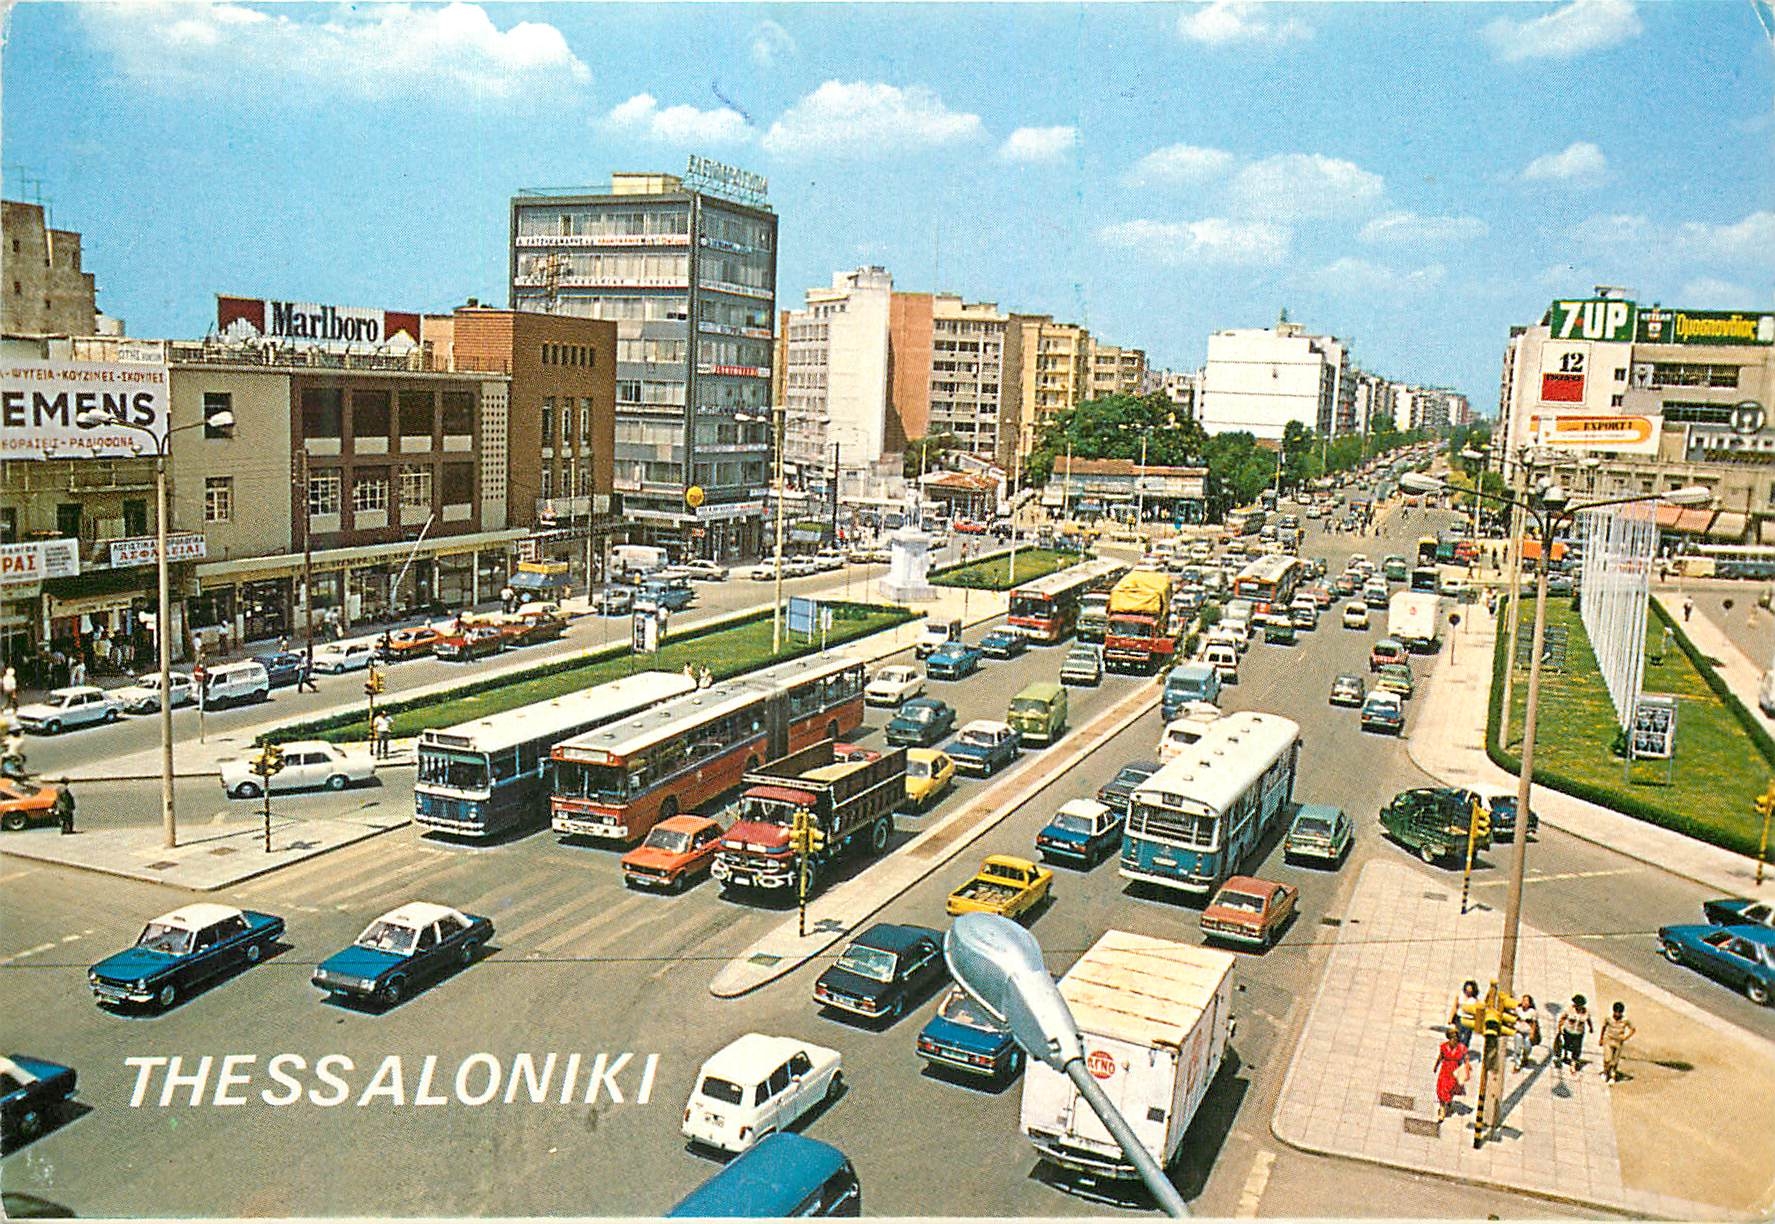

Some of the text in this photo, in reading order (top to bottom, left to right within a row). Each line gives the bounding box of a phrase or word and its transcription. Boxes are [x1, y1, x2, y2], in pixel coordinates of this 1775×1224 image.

[272, 301, 379, 342] Marlboro
[1558, 301, 1629, 339] 7UP
[1559, 351, 1585, 373] 12
